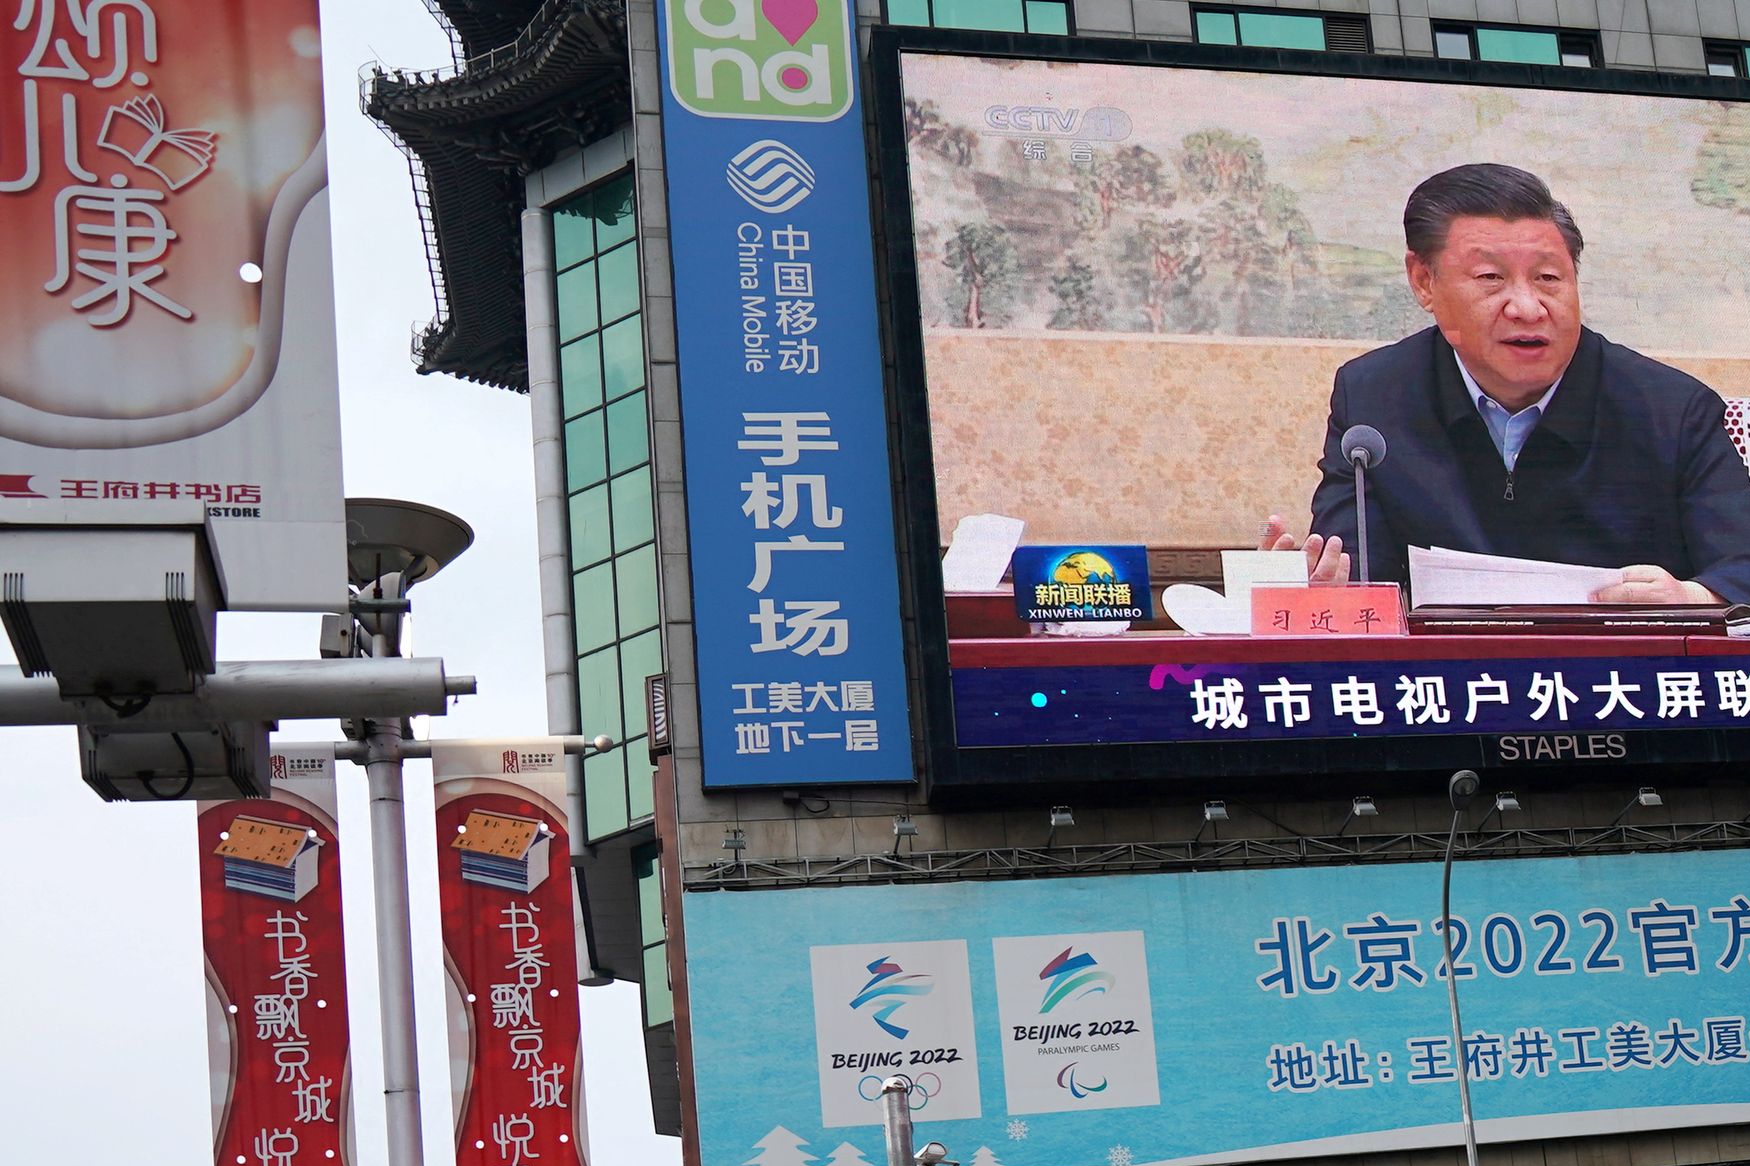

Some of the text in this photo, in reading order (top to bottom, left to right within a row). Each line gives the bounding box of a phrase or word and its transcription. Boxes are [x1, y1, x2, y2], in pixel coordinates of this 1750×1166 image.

[984, 104, 1080, 134] CCTV
[736, 221, 773, 375] China Mobile
[771, 223, 822, 376] 中国移动
[60, 479, 262, 504] 王府井书店
[206, 506, 261, 518] STORE
[737, 410, 850, 658] 手机广场
[1035, 583, 1132, 606] 新闻联播
[1028, 607, 1143, 619] XINWEN LIANBO
[1272, 607, 1382, 634] 习近平
[732, 680, 876, 715] 工美大厦
[734, 719, 880, 755] 地下一层
[1499, 733, 1628, 760] STAPLES
[1012, 1019, 1140, 1044] BEIJING 2022
[831, 1047, 963, 1073] BEIJING 2022
[1037, 1042, 1121, 1056] PARALYMPIC GAMES
